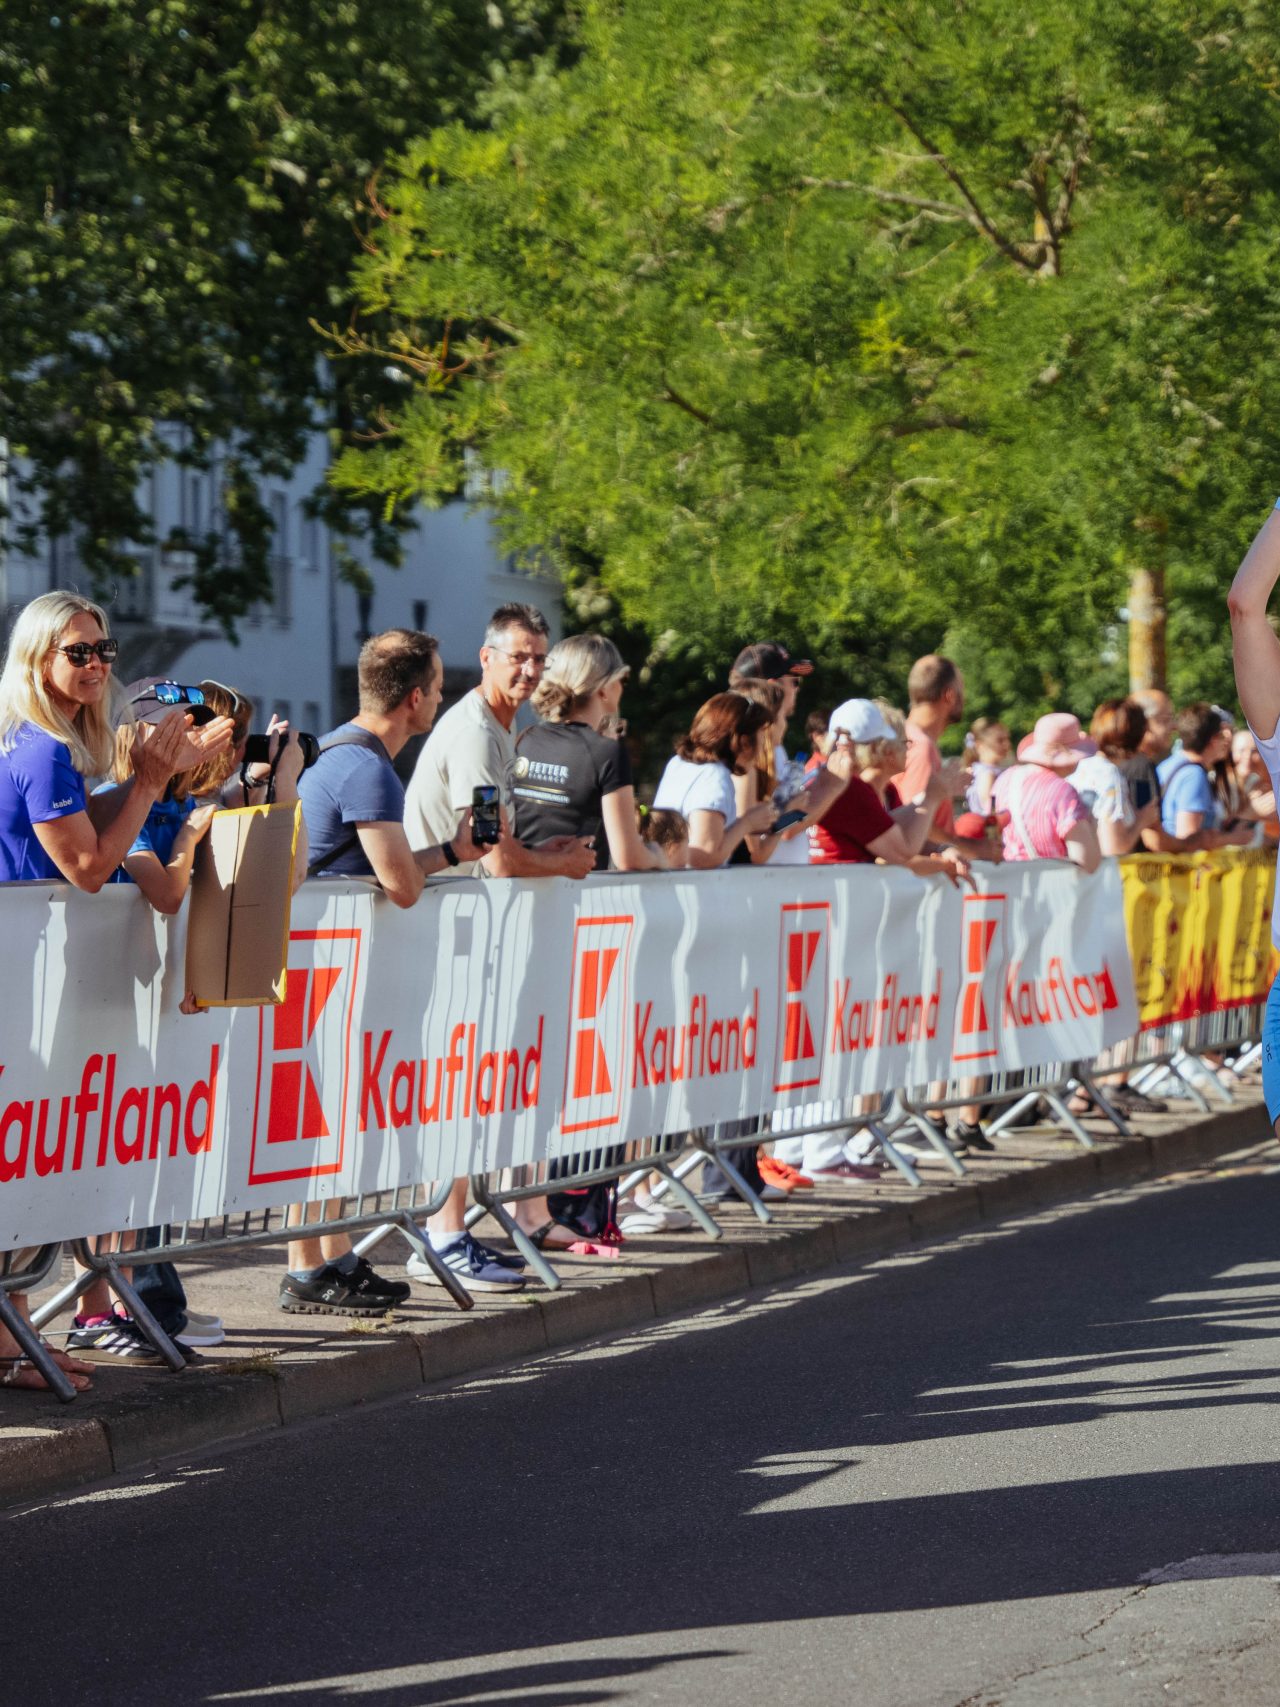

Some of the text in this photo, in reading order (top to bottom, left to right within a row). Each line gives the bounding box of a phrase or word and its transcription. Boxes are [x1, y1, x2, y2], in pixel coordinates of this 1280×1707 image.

[631, 987, 758, 1088] Kaufland
[831, 968, 942, 1055] Kaufland
[0, 1044, 219, 1182] aufland
[359, 1016, 544, 1132] Kaufland
